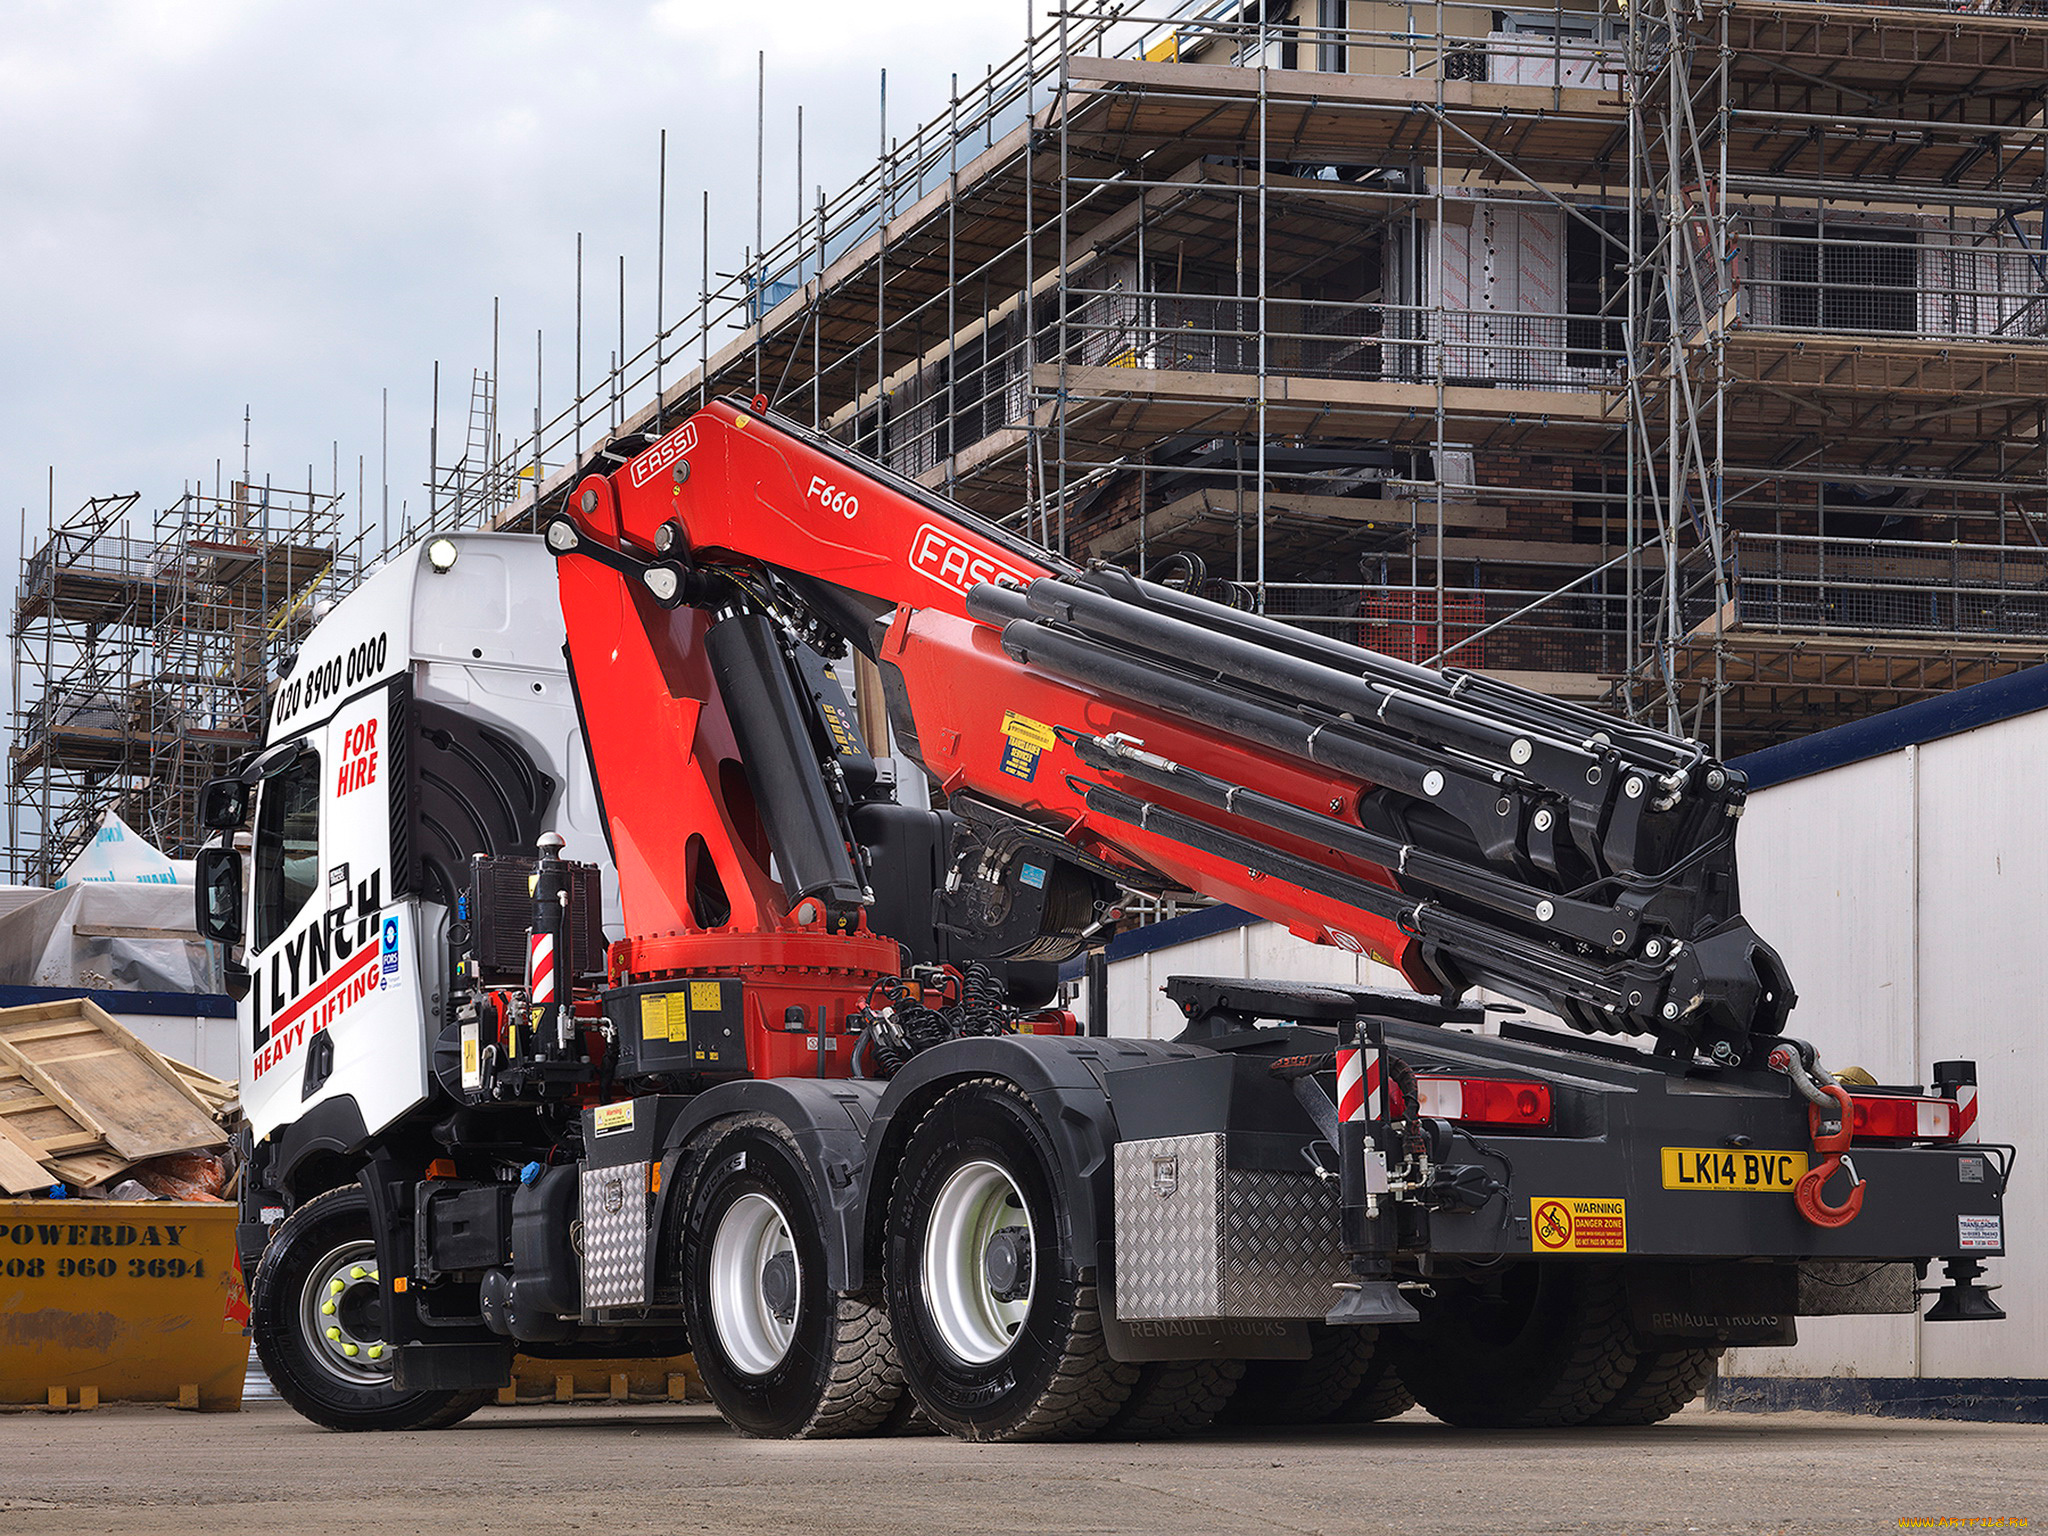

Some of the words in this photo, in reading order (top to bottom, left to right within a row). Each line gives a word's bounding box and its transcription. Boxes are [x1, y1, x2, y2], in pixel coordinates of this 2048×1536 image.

[636, 431, 693, 481] FASSI
[806, 474, 860, 520] F660
[917, 532, 1028, 590] FAS
[276, 677, 302, 726] 020
[304, 654, 342, 709] 8900
[346, 631, 388, 688] 0000
[342, 717, 378, 762] FOR
[336, 750, 379, 799] HIRE
[271, 867, 382, 1017] LYNCH
[253, 1018, 307, 1082] HEAVY
[312, 962, 380, 1036] LIFTING
[1677, 1152, 1737, 1185] LK14
[1743, 1154, 1794, 1186] BVC
[1573, 1202, 1623, 1214] WARNING
[1575, 1218, 1603, 1229] DANGER
[1604, 1219, 1623, 1229] ZONE
[0, 1258, 45, 1278] 08
[58, 1258, 117, 1278] 960
[128, 1258, 205, 1278] 3694
[1130, 1321, 1212, 1338] RENAULT
